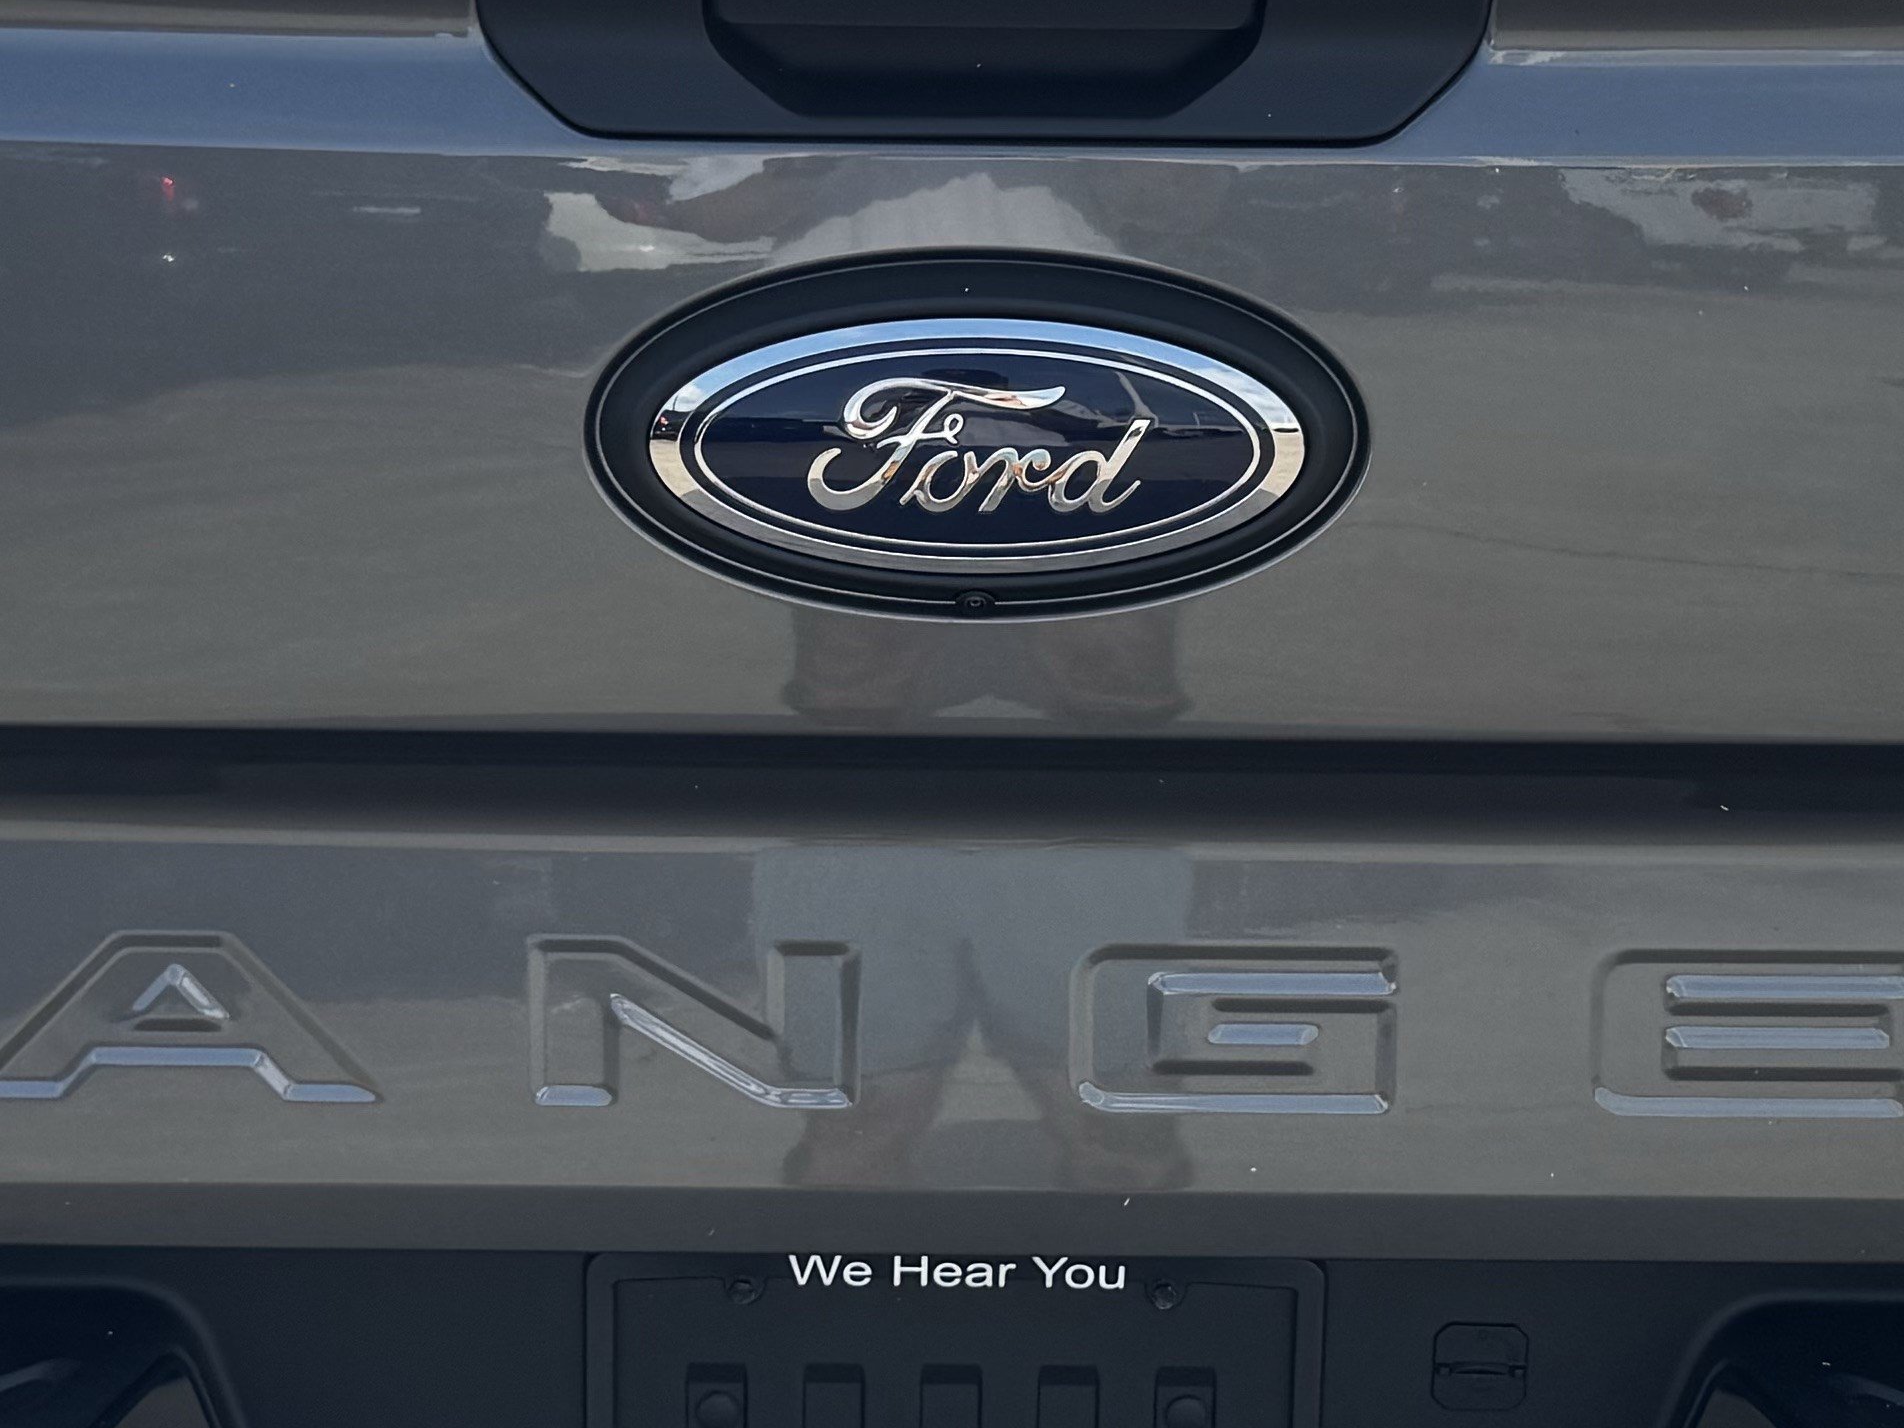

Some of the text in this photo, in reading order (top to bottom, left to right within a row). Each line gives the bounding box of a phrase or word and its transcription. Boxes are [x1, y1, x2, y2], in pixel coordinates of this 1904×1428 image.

[807, 376, 1151, 514] Ford
[788, 1254, 1127, 1290] We Hear You
